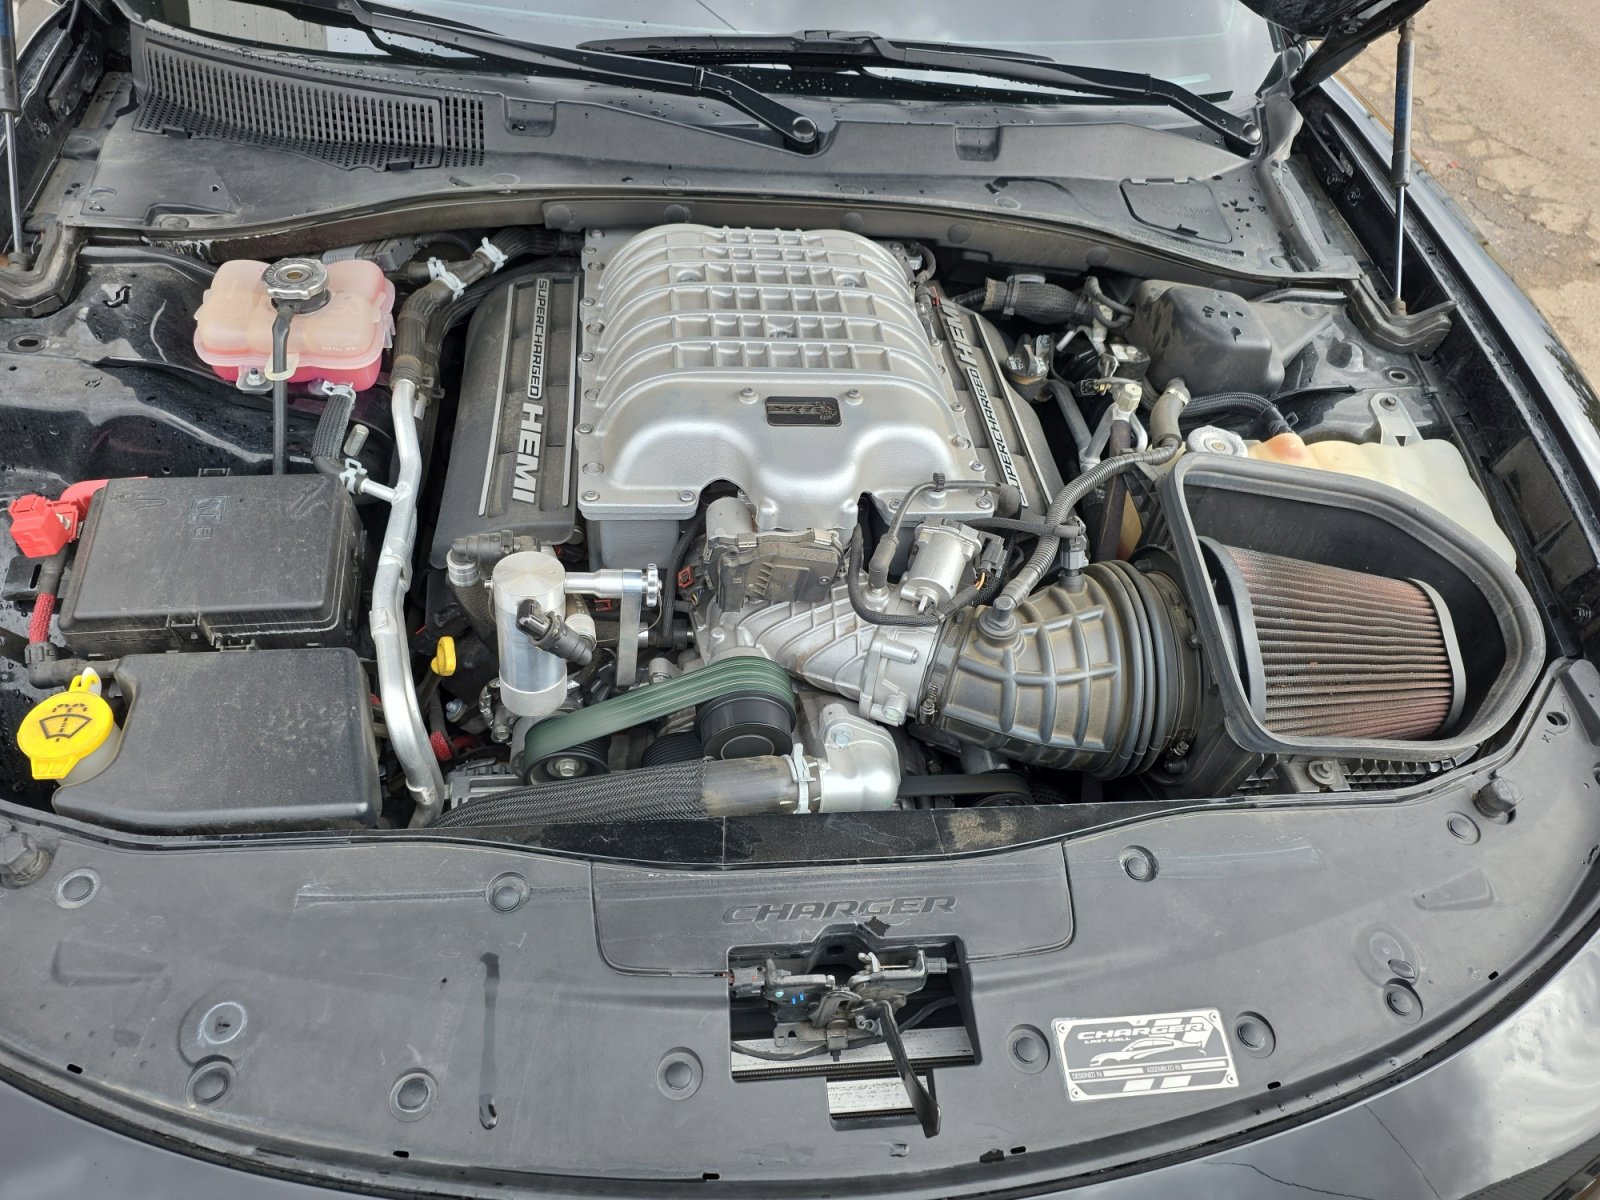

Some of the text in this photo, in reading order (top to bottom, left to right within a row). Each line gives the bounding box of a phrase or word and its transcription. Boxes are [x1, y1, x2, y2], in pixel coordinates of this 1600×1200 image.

[941, 299, 977, 367] HEMI
[513, 279, 548, 504] SUPERCHARGED HEMI
[722, 895, 957, 924] CHARGER
[1077, 1022, 1207, 1040] CHARGER
